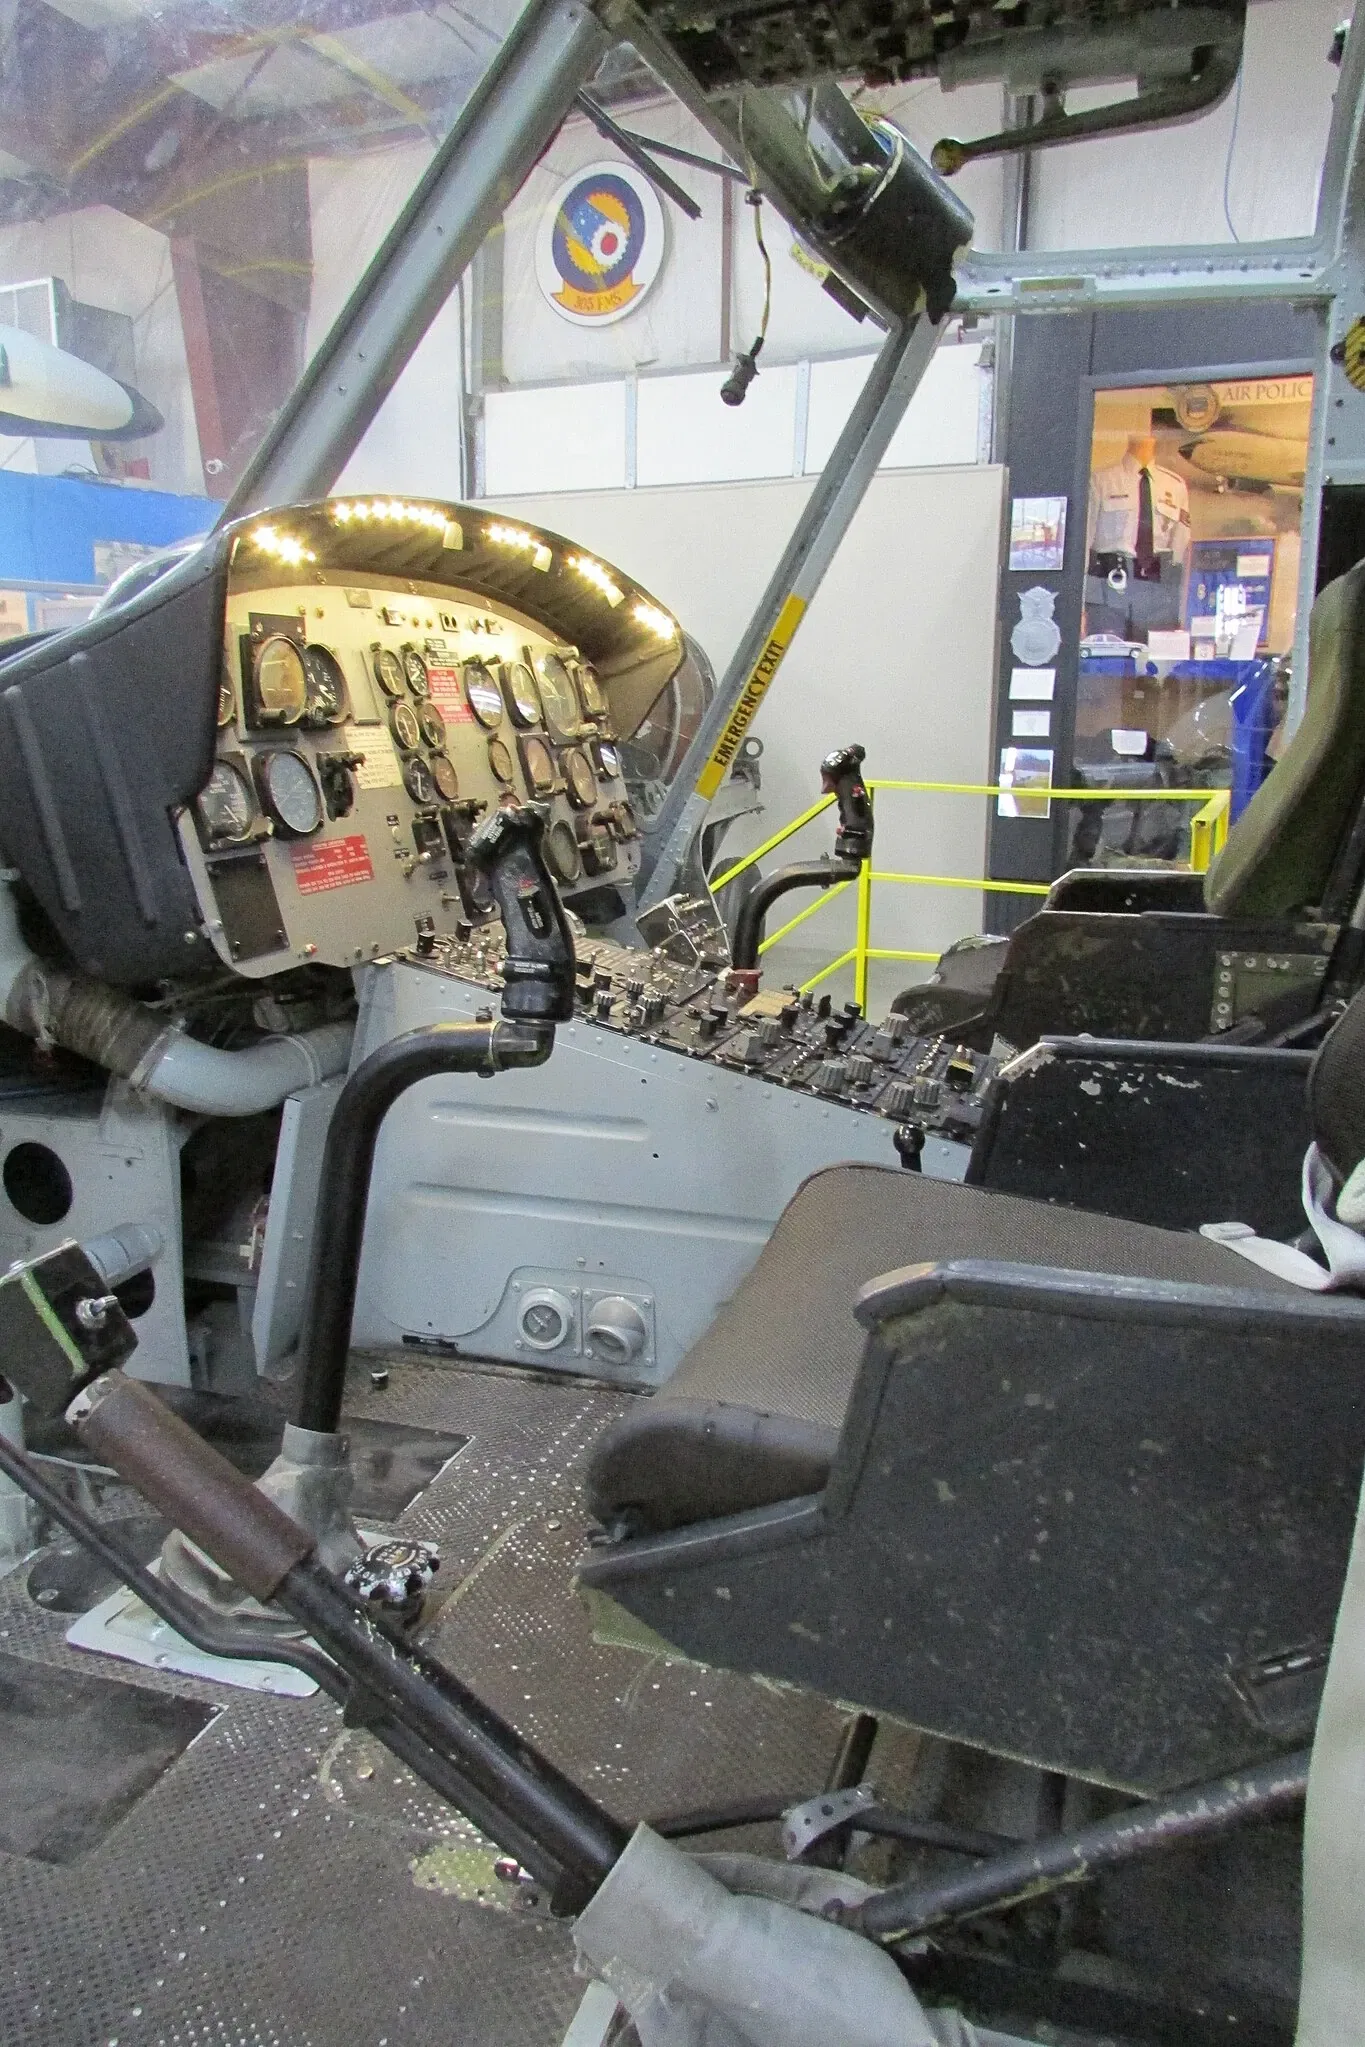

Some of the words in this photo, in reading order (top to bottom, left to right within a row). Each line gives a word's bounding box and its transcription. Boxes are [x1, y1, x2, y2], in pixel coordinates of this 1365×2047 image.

[1224, 387, 1251, 401] AIR
[714, 677, 766, 767] EMERGENCY
[759, 639, 784, 675] EXIT
